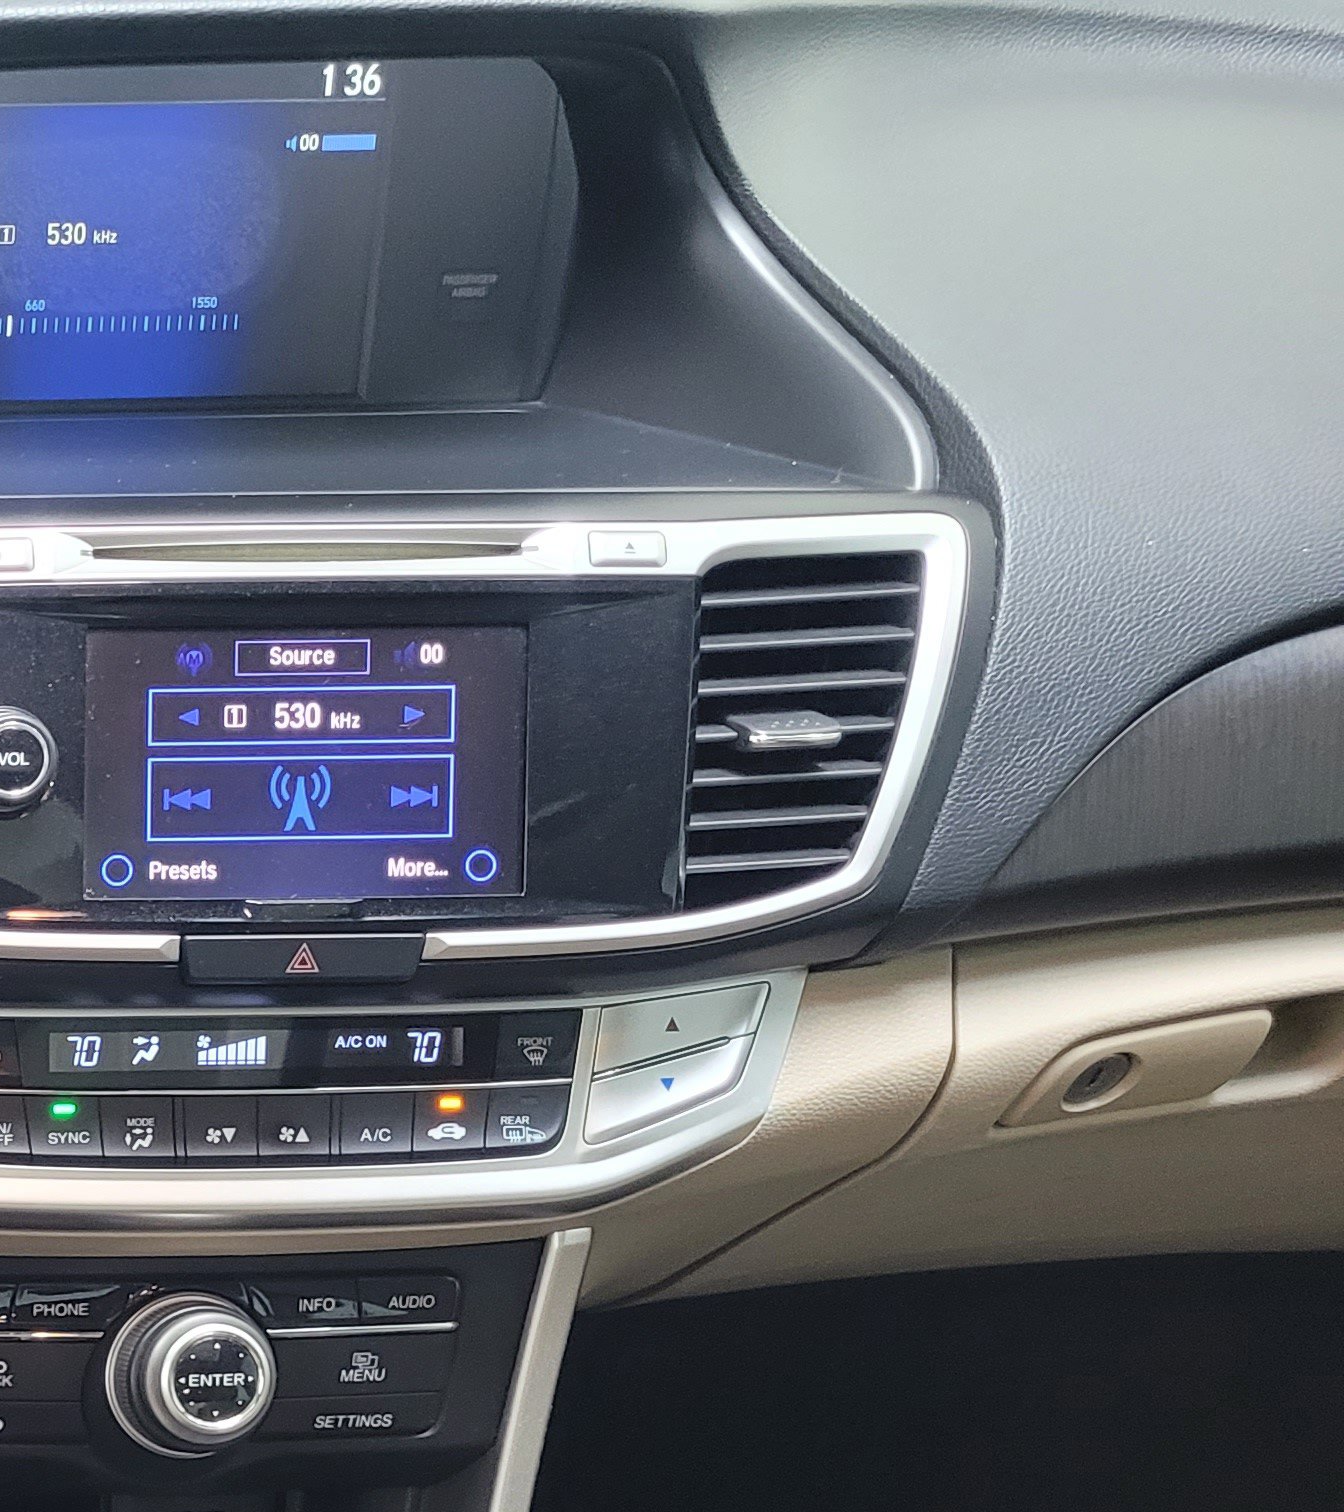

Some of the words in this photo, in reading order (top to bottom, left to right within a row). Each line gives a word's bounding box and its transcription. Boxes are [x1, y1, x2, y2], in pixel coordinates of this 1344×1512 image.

[299, 133, 319, 151] 00
[47, 222, 87, 246] 530
[93, 230, 118, 244] kHz
[24, 299, 45, 312] 660
[192, 296, 218, 309] 1550
[269, 646, 335, 666] Source
[419, 643, 444, 665] 00
[274, 702, 320, 729] 530
[330, 712, 361, 729] kHz
[148, 860, 217, 880] Presets
[335, 1035, 362, 1049] A/C
[365, 1035, 387, 1049] ON
[407, 1031, 442, 1063] 70
[517, 1036, 553, 1047] FRONT
[67, 1036, 101, 1067] 70
[126, 1118, 155, 1127] MODE
[500, 1115, 529, 1125] REAR
[48, 1132, 90, 1144] SYNC
[360, 1128, 392, 1143] A/C
[298, 1298, 336, 1313] INFO
[388, 1295, 436, 1309] AUDIO
[32, 1303, 89, 1317] PHONE
[188, 1373, 245, 1387] ENTER
[340, 1368, 386, 1383] MENU
[314, 1413, 393, 1429] SETTINGS
